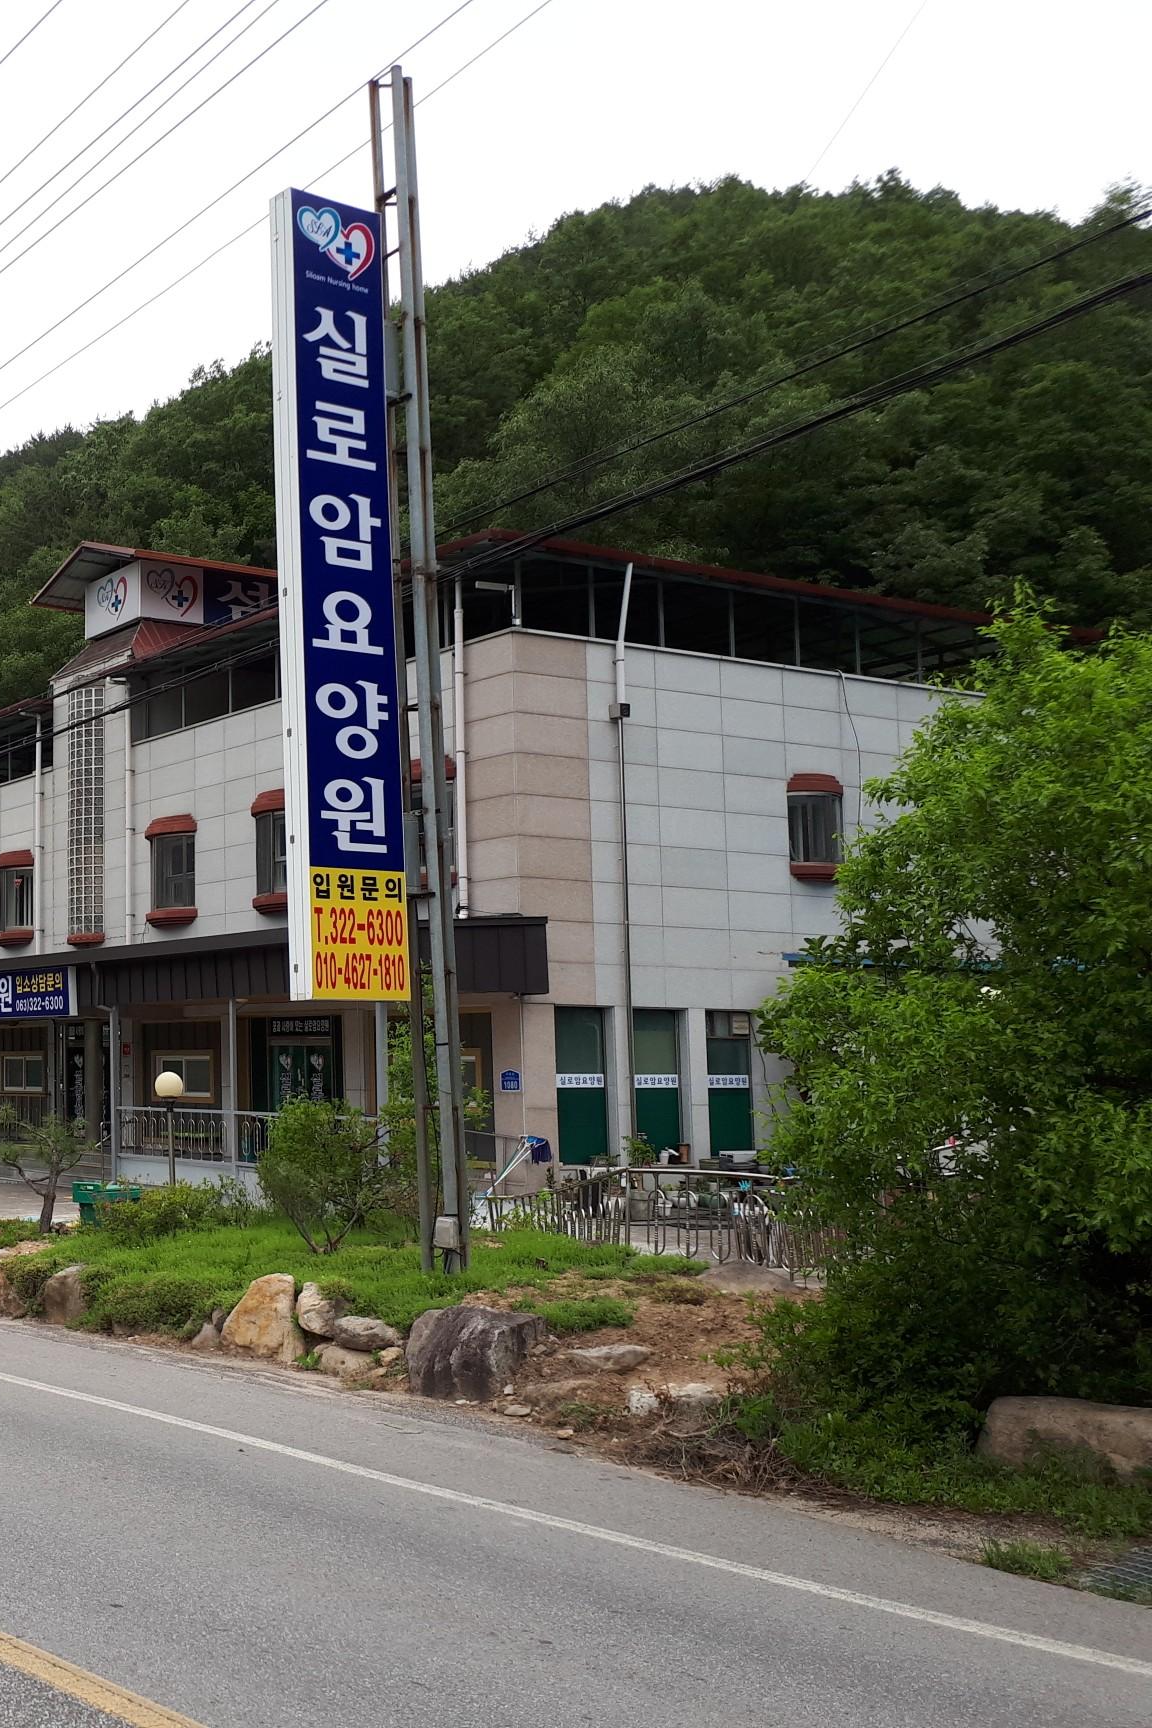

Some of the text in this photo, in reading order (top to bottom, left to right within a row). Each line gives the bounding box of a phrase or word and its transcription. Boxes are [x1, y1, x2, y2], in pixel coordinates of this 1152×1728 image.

[327, 275, 351, 291] Nursing
[351, 283, 369, 294] home
[302, 305, 389, 854] 실로암요양원
[312, 873, 402, 903] 입원문의
[314, 907, 403, 946] T.322-6300
[315, 951, 405, 991] 010-4627-1810
[16, 972, 63, 993] 입소상담문의
[16, 995, 64, 1012] 063)322-6300
[559, 1075, 604, 1086] 실로암요양원
[635, 1076, 678, 1086] 실로암요양원
[708, 1076, 748, 1086] 실로암요양원
